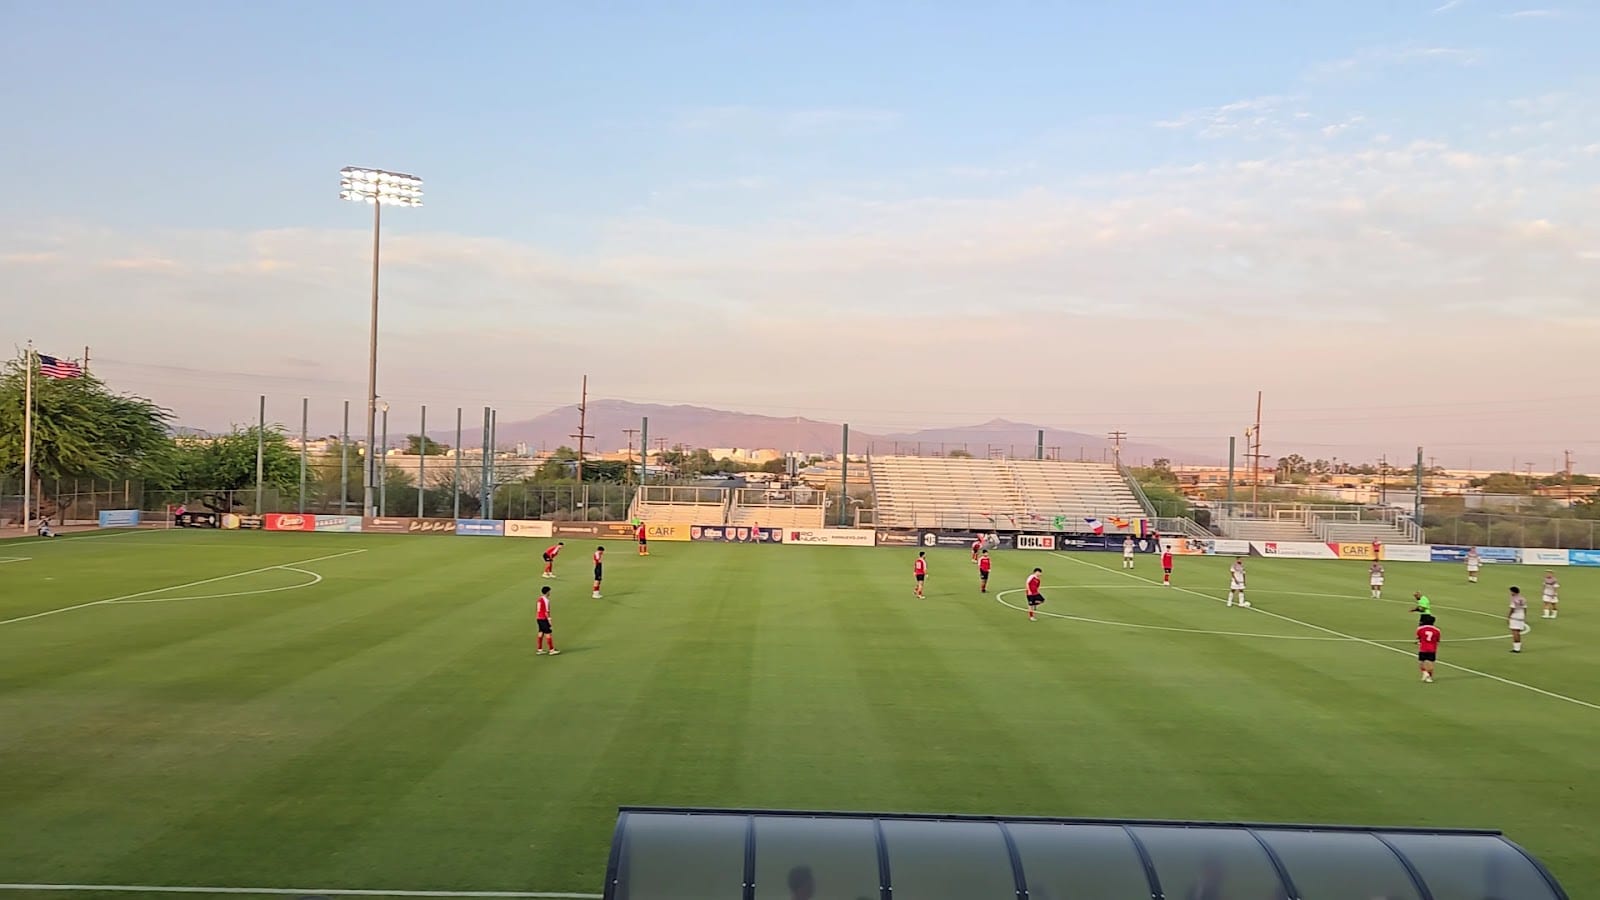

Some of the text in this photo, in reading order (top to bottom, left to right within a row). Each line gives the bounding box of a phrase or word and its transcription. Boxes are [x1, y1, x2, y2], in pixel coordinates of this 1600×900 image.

[648, 526, 676, 536] CARF
[1020, 537, 1043, 547] USL
[1343, 545, 1369, 555] CARF
[1425, 630, 1433, 642] 7
